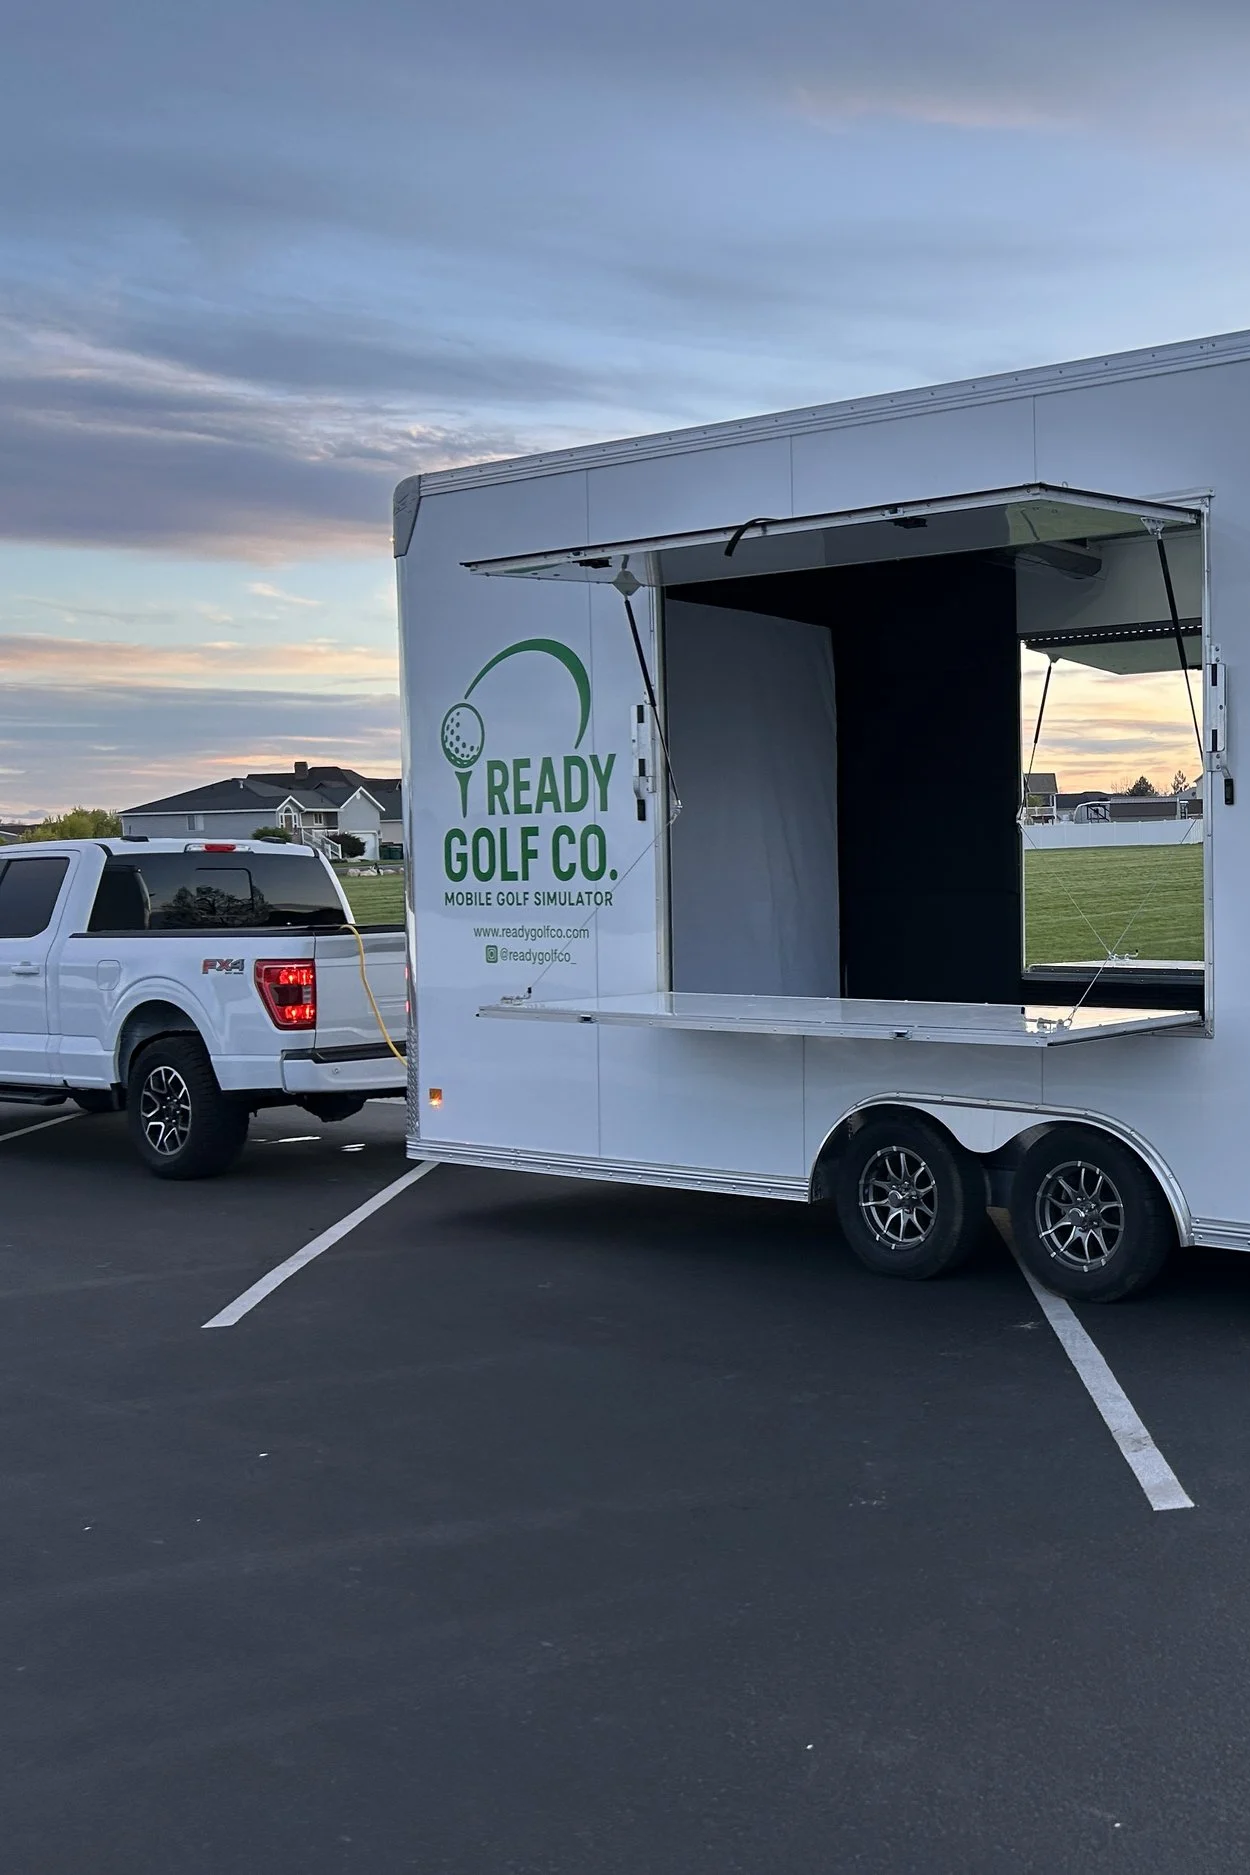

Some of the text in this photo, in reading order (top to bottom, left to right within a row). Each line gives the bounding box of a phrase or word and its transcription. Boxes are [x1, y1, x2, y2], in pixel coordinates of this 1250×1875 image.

[486, 753, 617, 816] READY
[444, 824, 618, 882] GOLF CO.
[444, 891, 614, 907] MOBILE GOLF SIMULATOR
[473, 925, 590, 942] www.readygolfco.com
[202, 958, 245, 974] FX4
